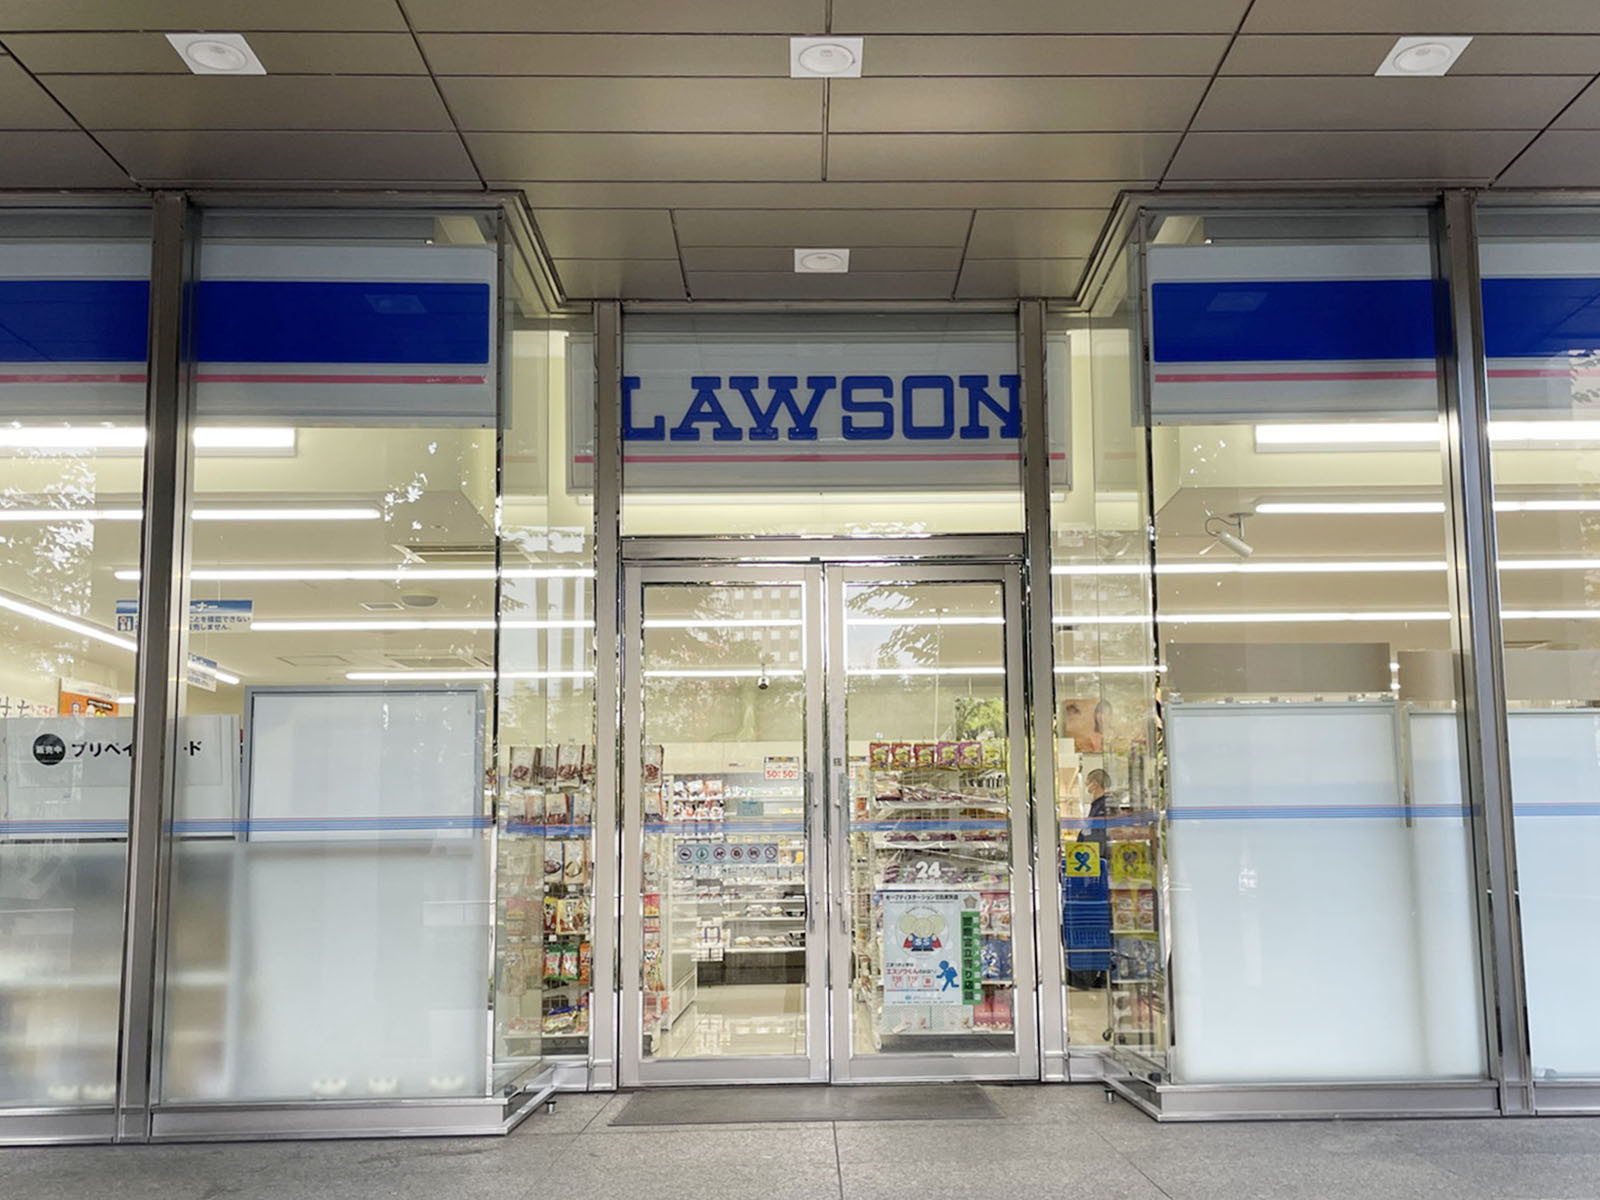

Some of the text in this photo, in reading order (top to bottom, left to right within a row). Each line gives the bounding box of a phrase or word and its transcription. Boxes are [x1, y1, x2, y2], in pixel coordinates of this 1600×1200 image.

[622, 375, 1022, 441] LAWSON
[71, 741, 202, 757] プリペイド
[915, 861, 941, 879] 24
